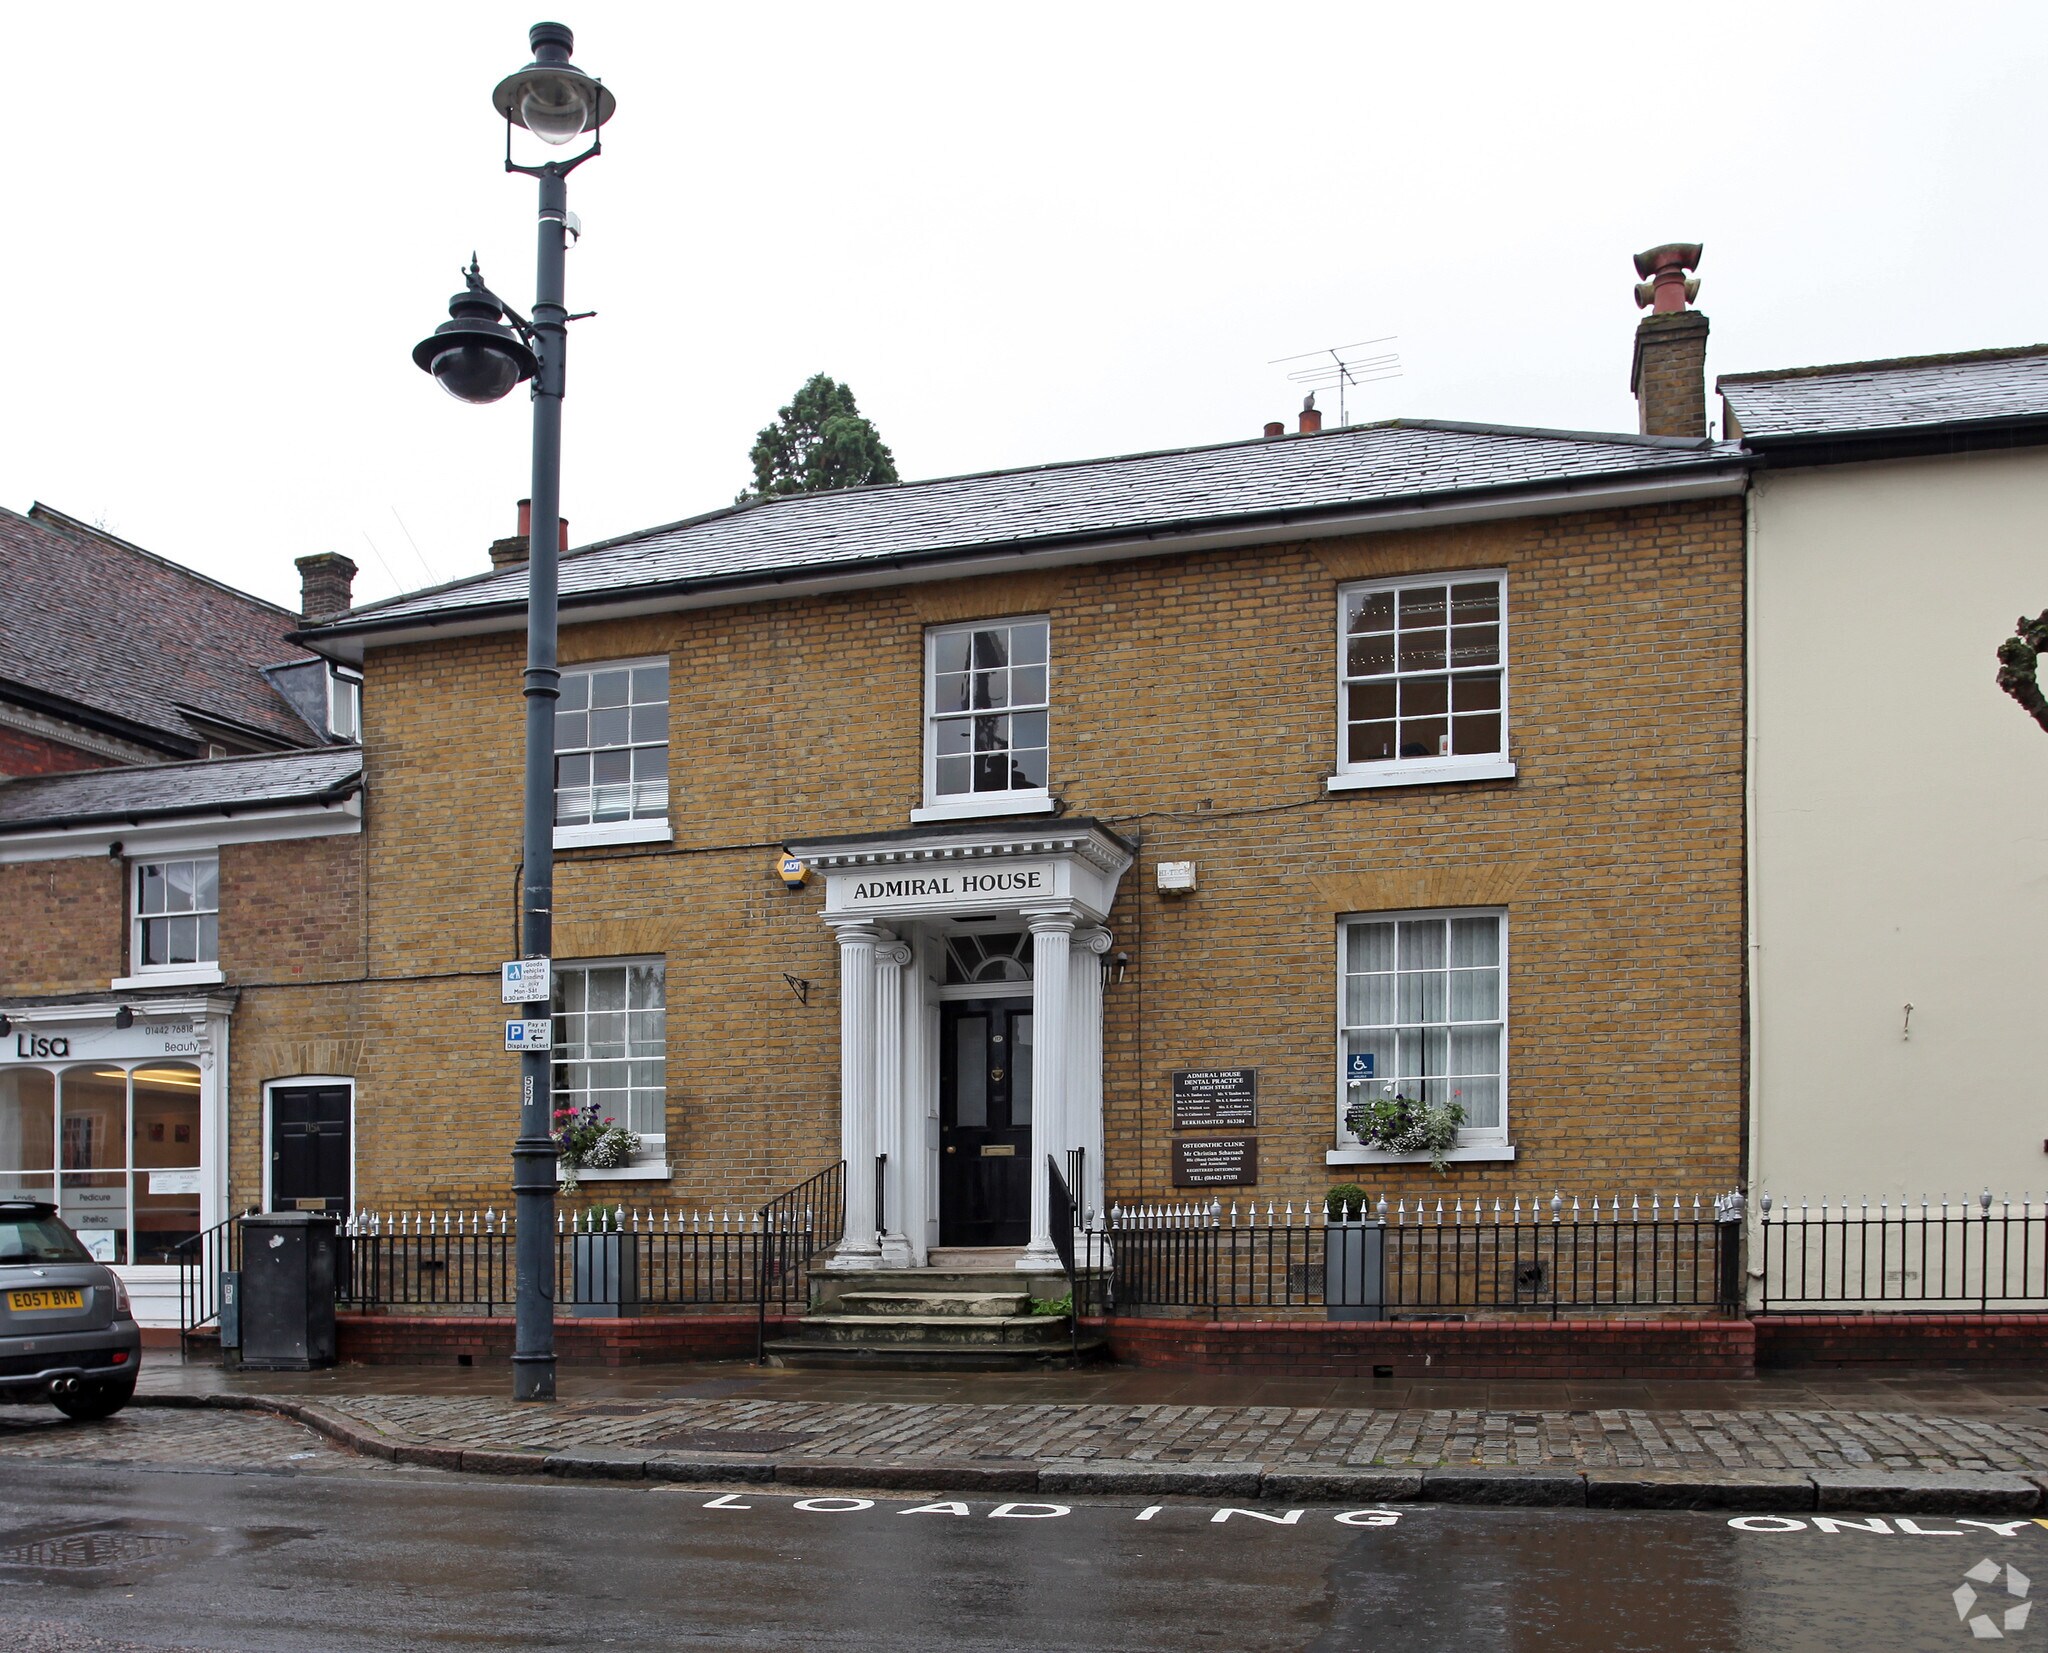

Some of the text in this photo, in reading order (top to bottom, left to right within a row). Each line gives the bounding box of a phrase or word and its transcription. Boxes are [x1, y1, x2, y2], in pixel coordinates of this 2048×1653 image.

[784, 860, 800, 870] ADT
[854, 872, 1041, 899] ADMIRAL HOUSE
[146, 1026, 169, 1035] 01442
[17, 1033, 70, 1057] Lisa
[165, 1042, 198, 1053] Beauty
[51, 1291, 77, 1306] BVR
[702, 1494, 2032, 1536] LOADING ONLY
